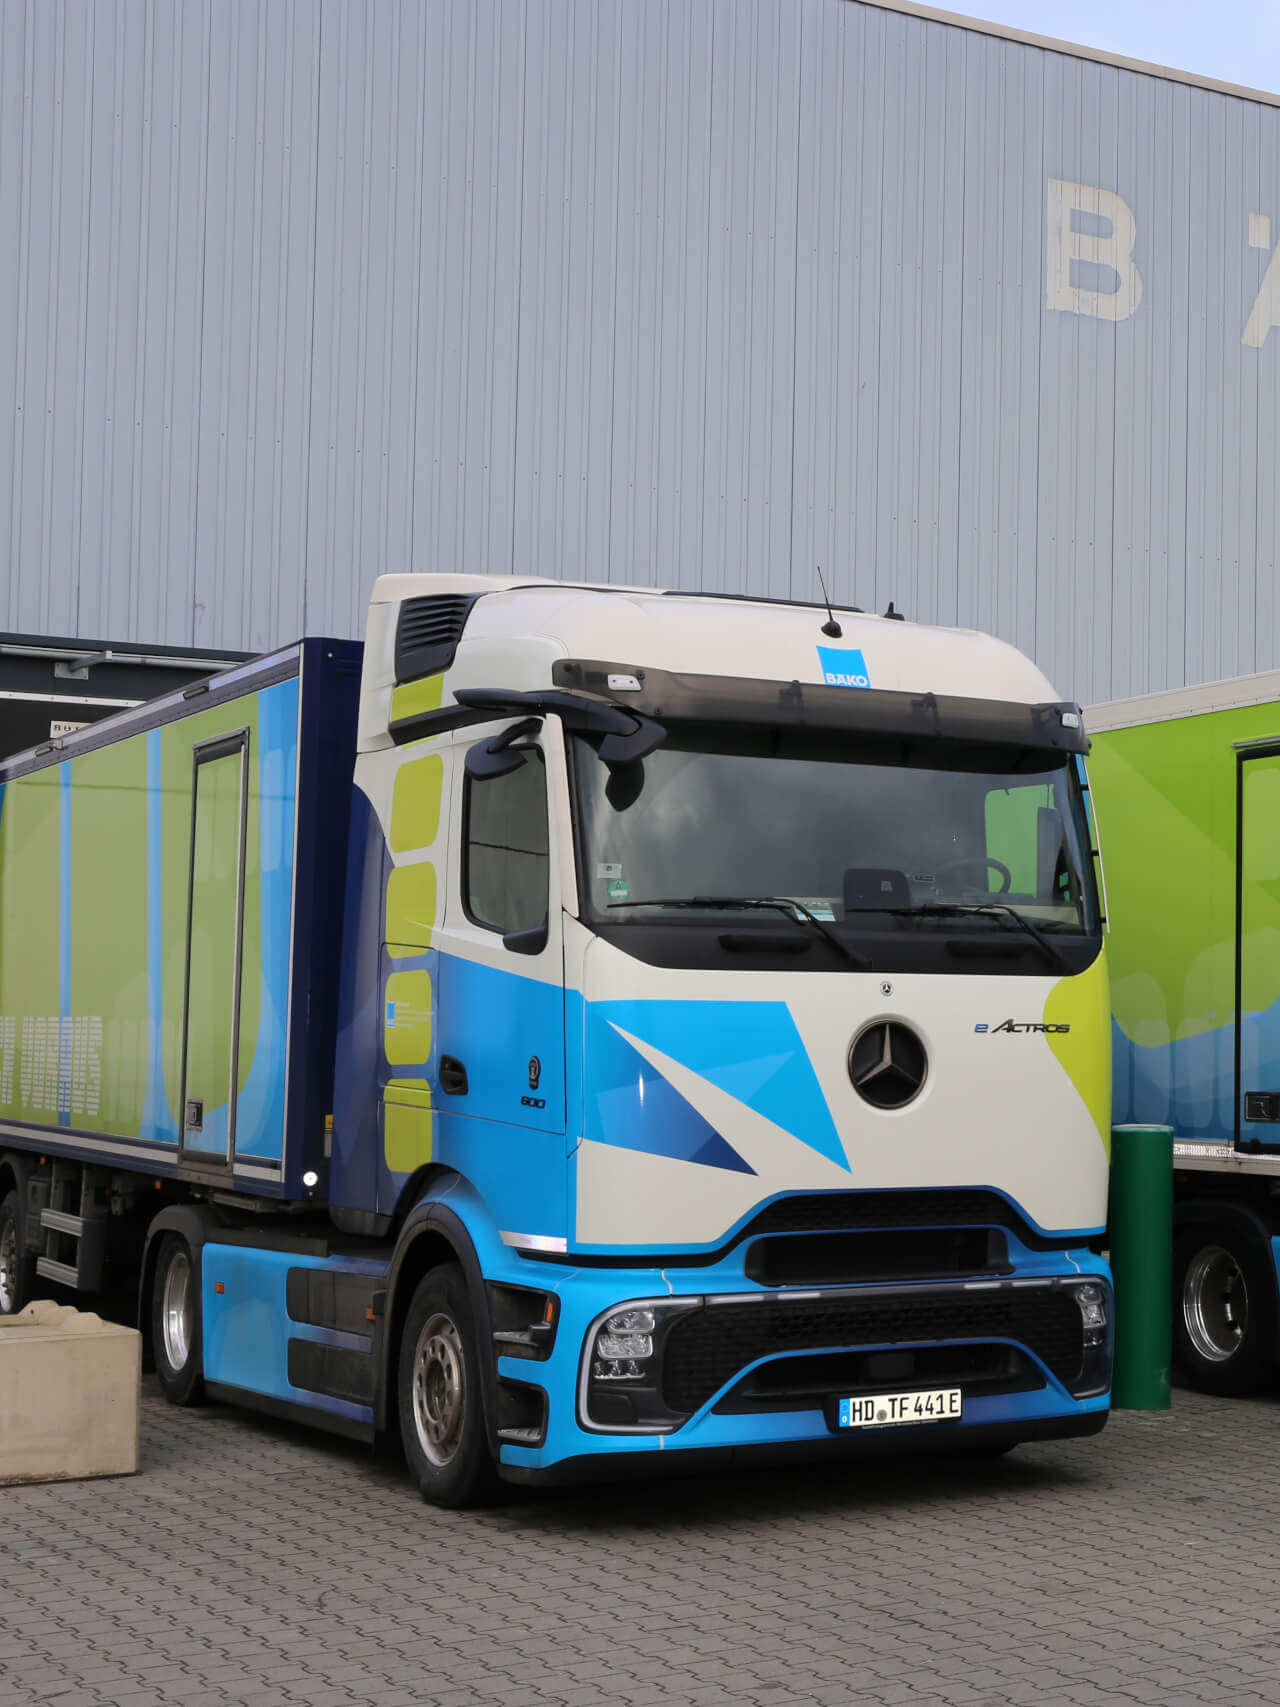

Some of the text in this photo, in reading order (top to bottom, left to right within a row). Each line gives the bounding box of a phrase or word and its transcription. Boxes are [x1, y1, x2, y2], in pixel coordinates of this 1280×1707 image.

[520, 1095, 546, 1109] 600
[852, 1400, 875, 1422] HD
[888, 1397, 909, 1418] TF
